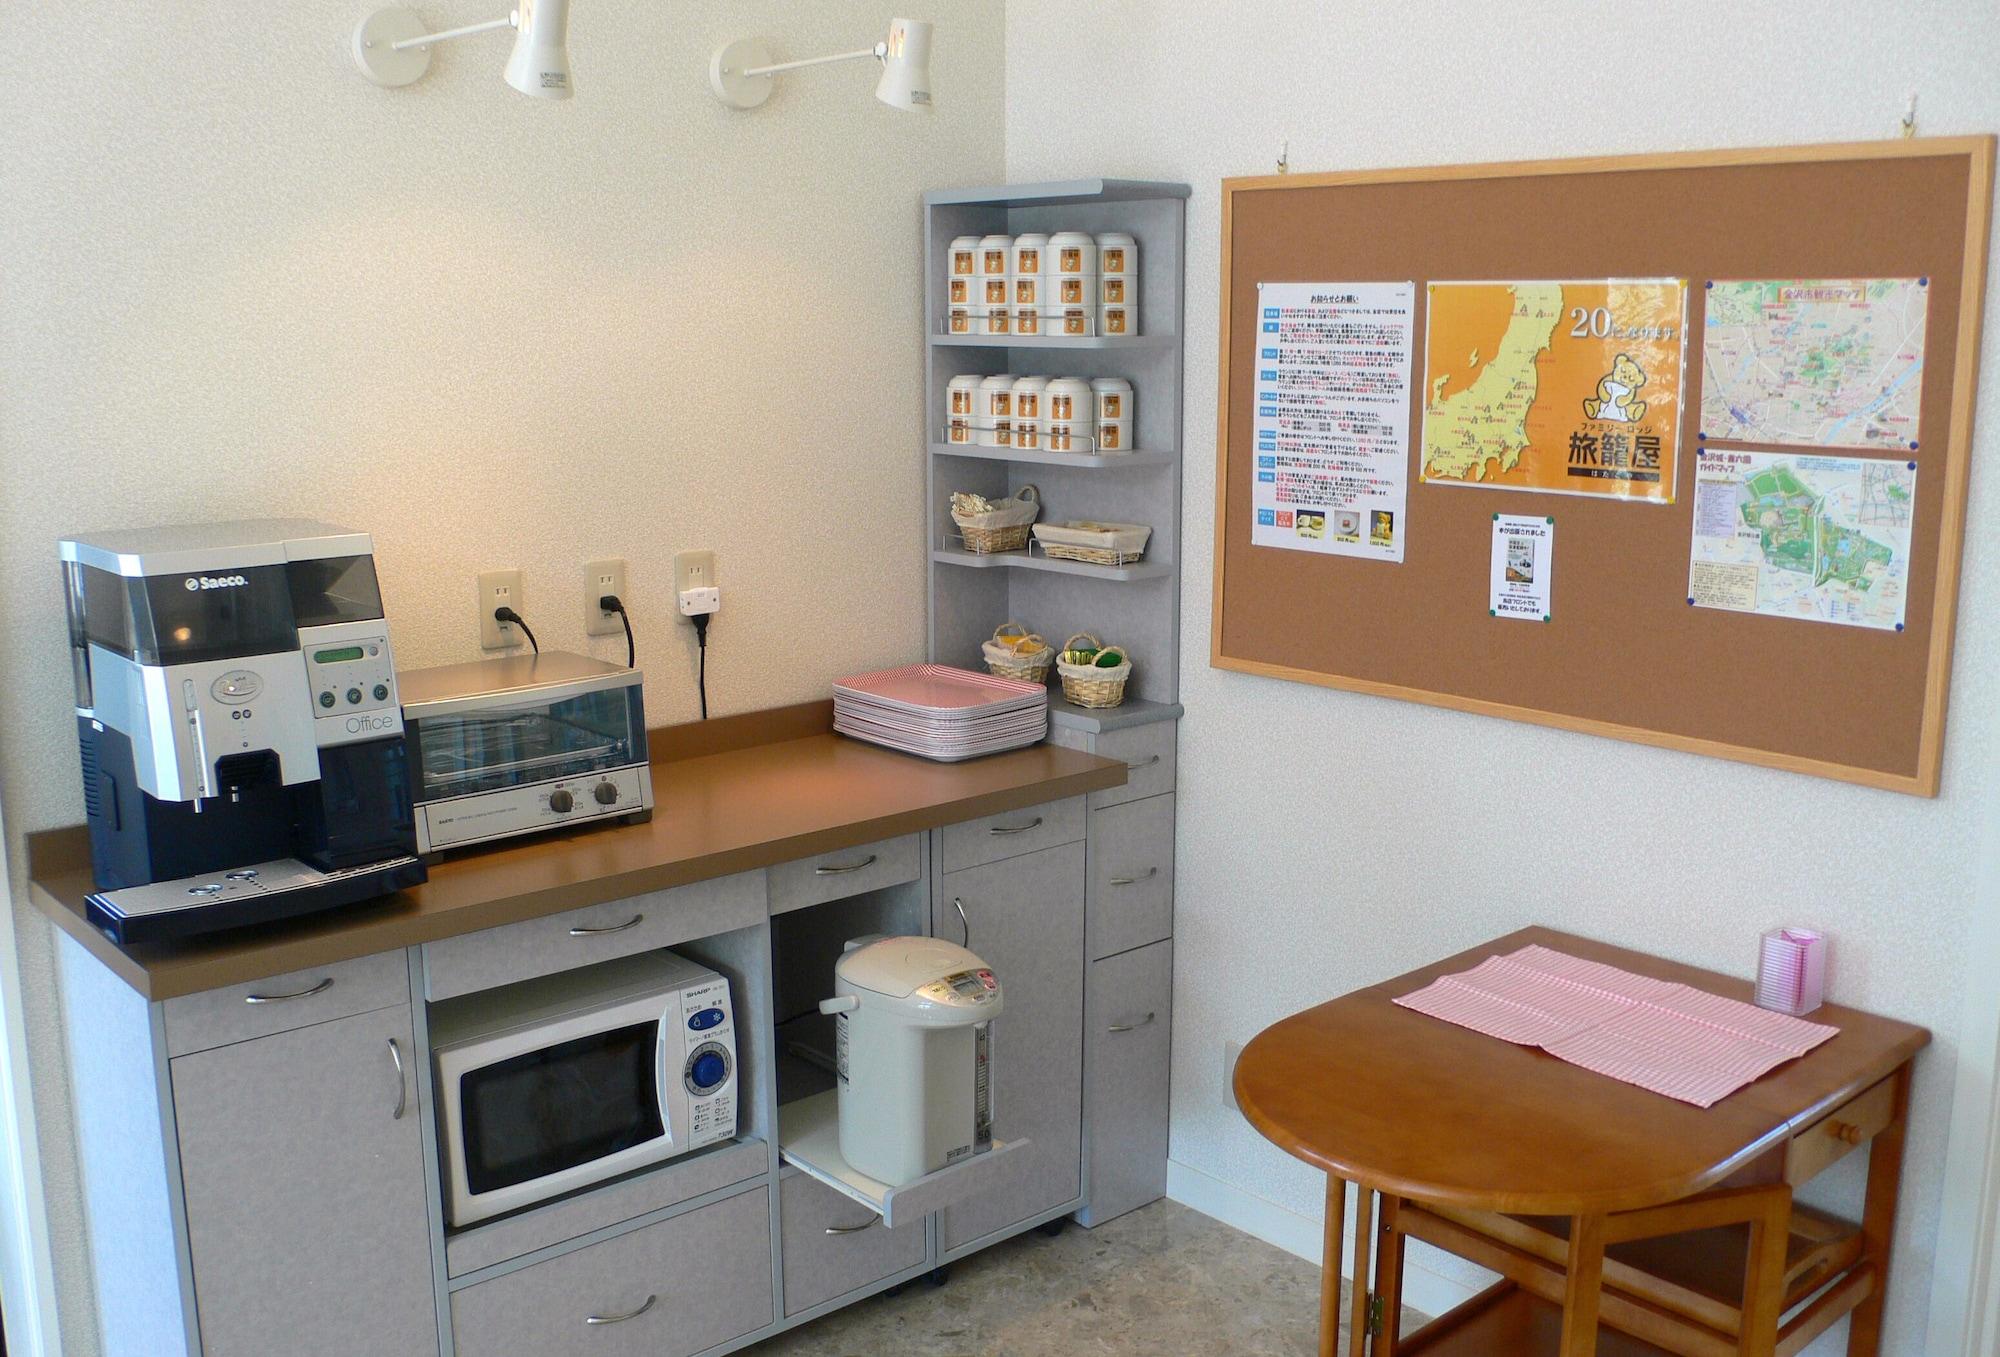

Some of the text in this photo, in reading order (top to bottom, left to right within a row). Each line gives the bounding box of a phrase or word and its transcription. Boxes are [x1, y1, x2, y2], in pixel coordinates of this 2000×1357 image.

[1311, 294, 1359, 304] お知らせとお願い
[1568, 431, 1660, 470] 旅籠屋
[345, 715, 393, 734] Office
[686, 987, 711, 998] SHARP
